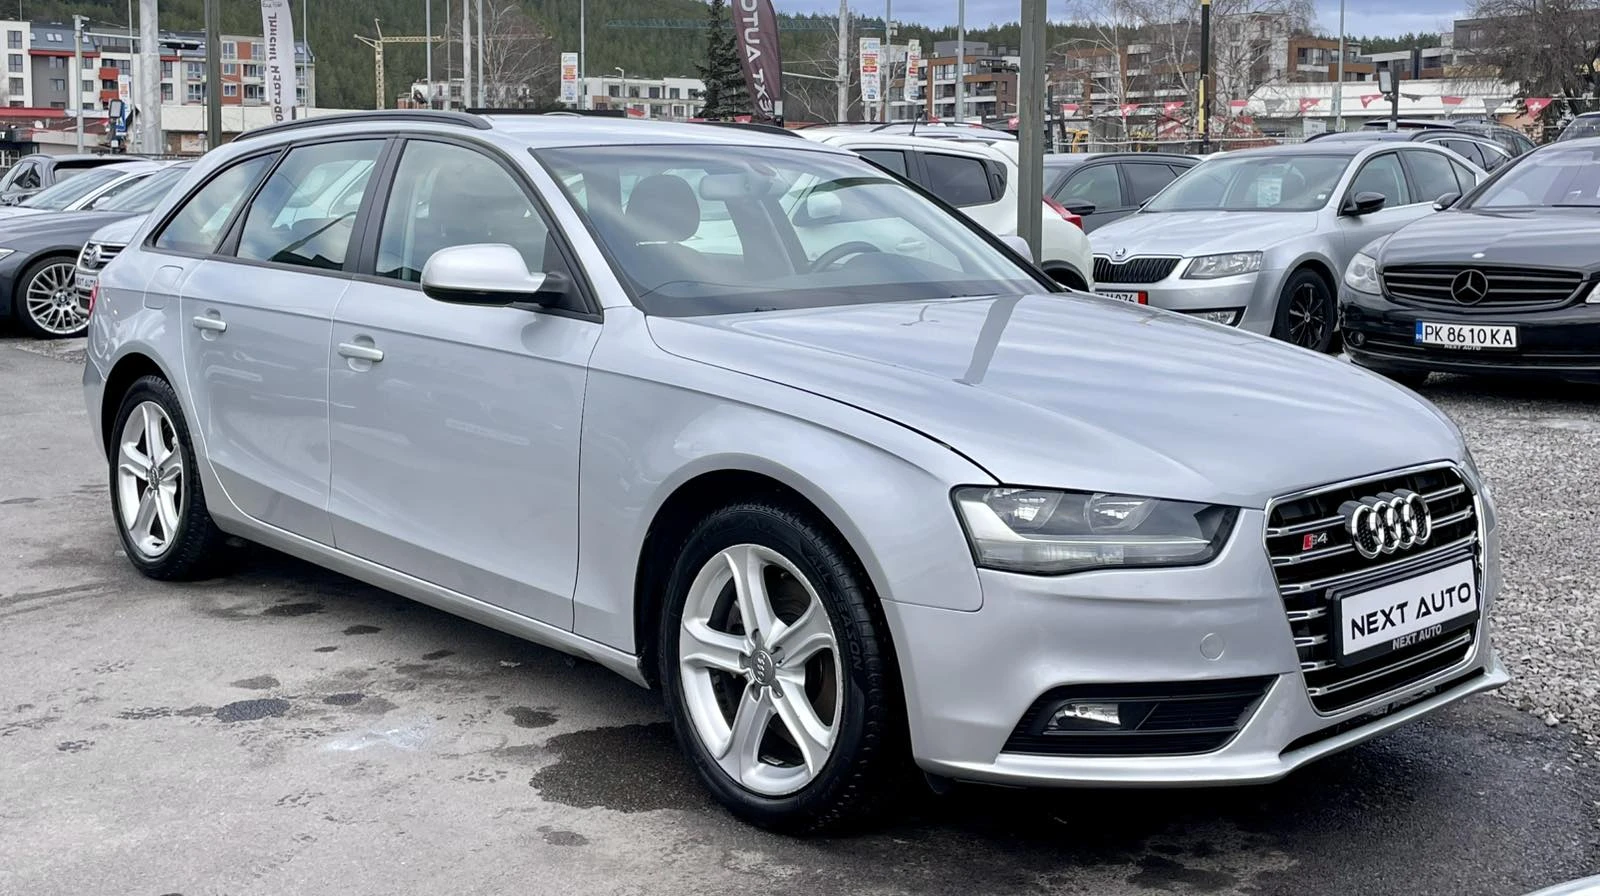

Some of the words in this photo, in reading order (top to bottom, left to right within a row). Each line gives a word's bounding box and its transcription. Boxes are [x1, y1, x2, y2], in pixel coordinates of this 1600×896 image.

[1425, 325, 1443, 342] PK
[1447, 327, 1487, 344] 8610
[1490, 329, 1513, 345] KA
[1303, 533, 1328, 549] S4
[1351, 601, 1408, 640] NEXT
[1415, 582, 1471, 619] AUTO
[830, 591, 863, 671] SEASON
[1392, 635, 1417, 650] NEXT
[1418, 624, 1442, 641] AUTO
